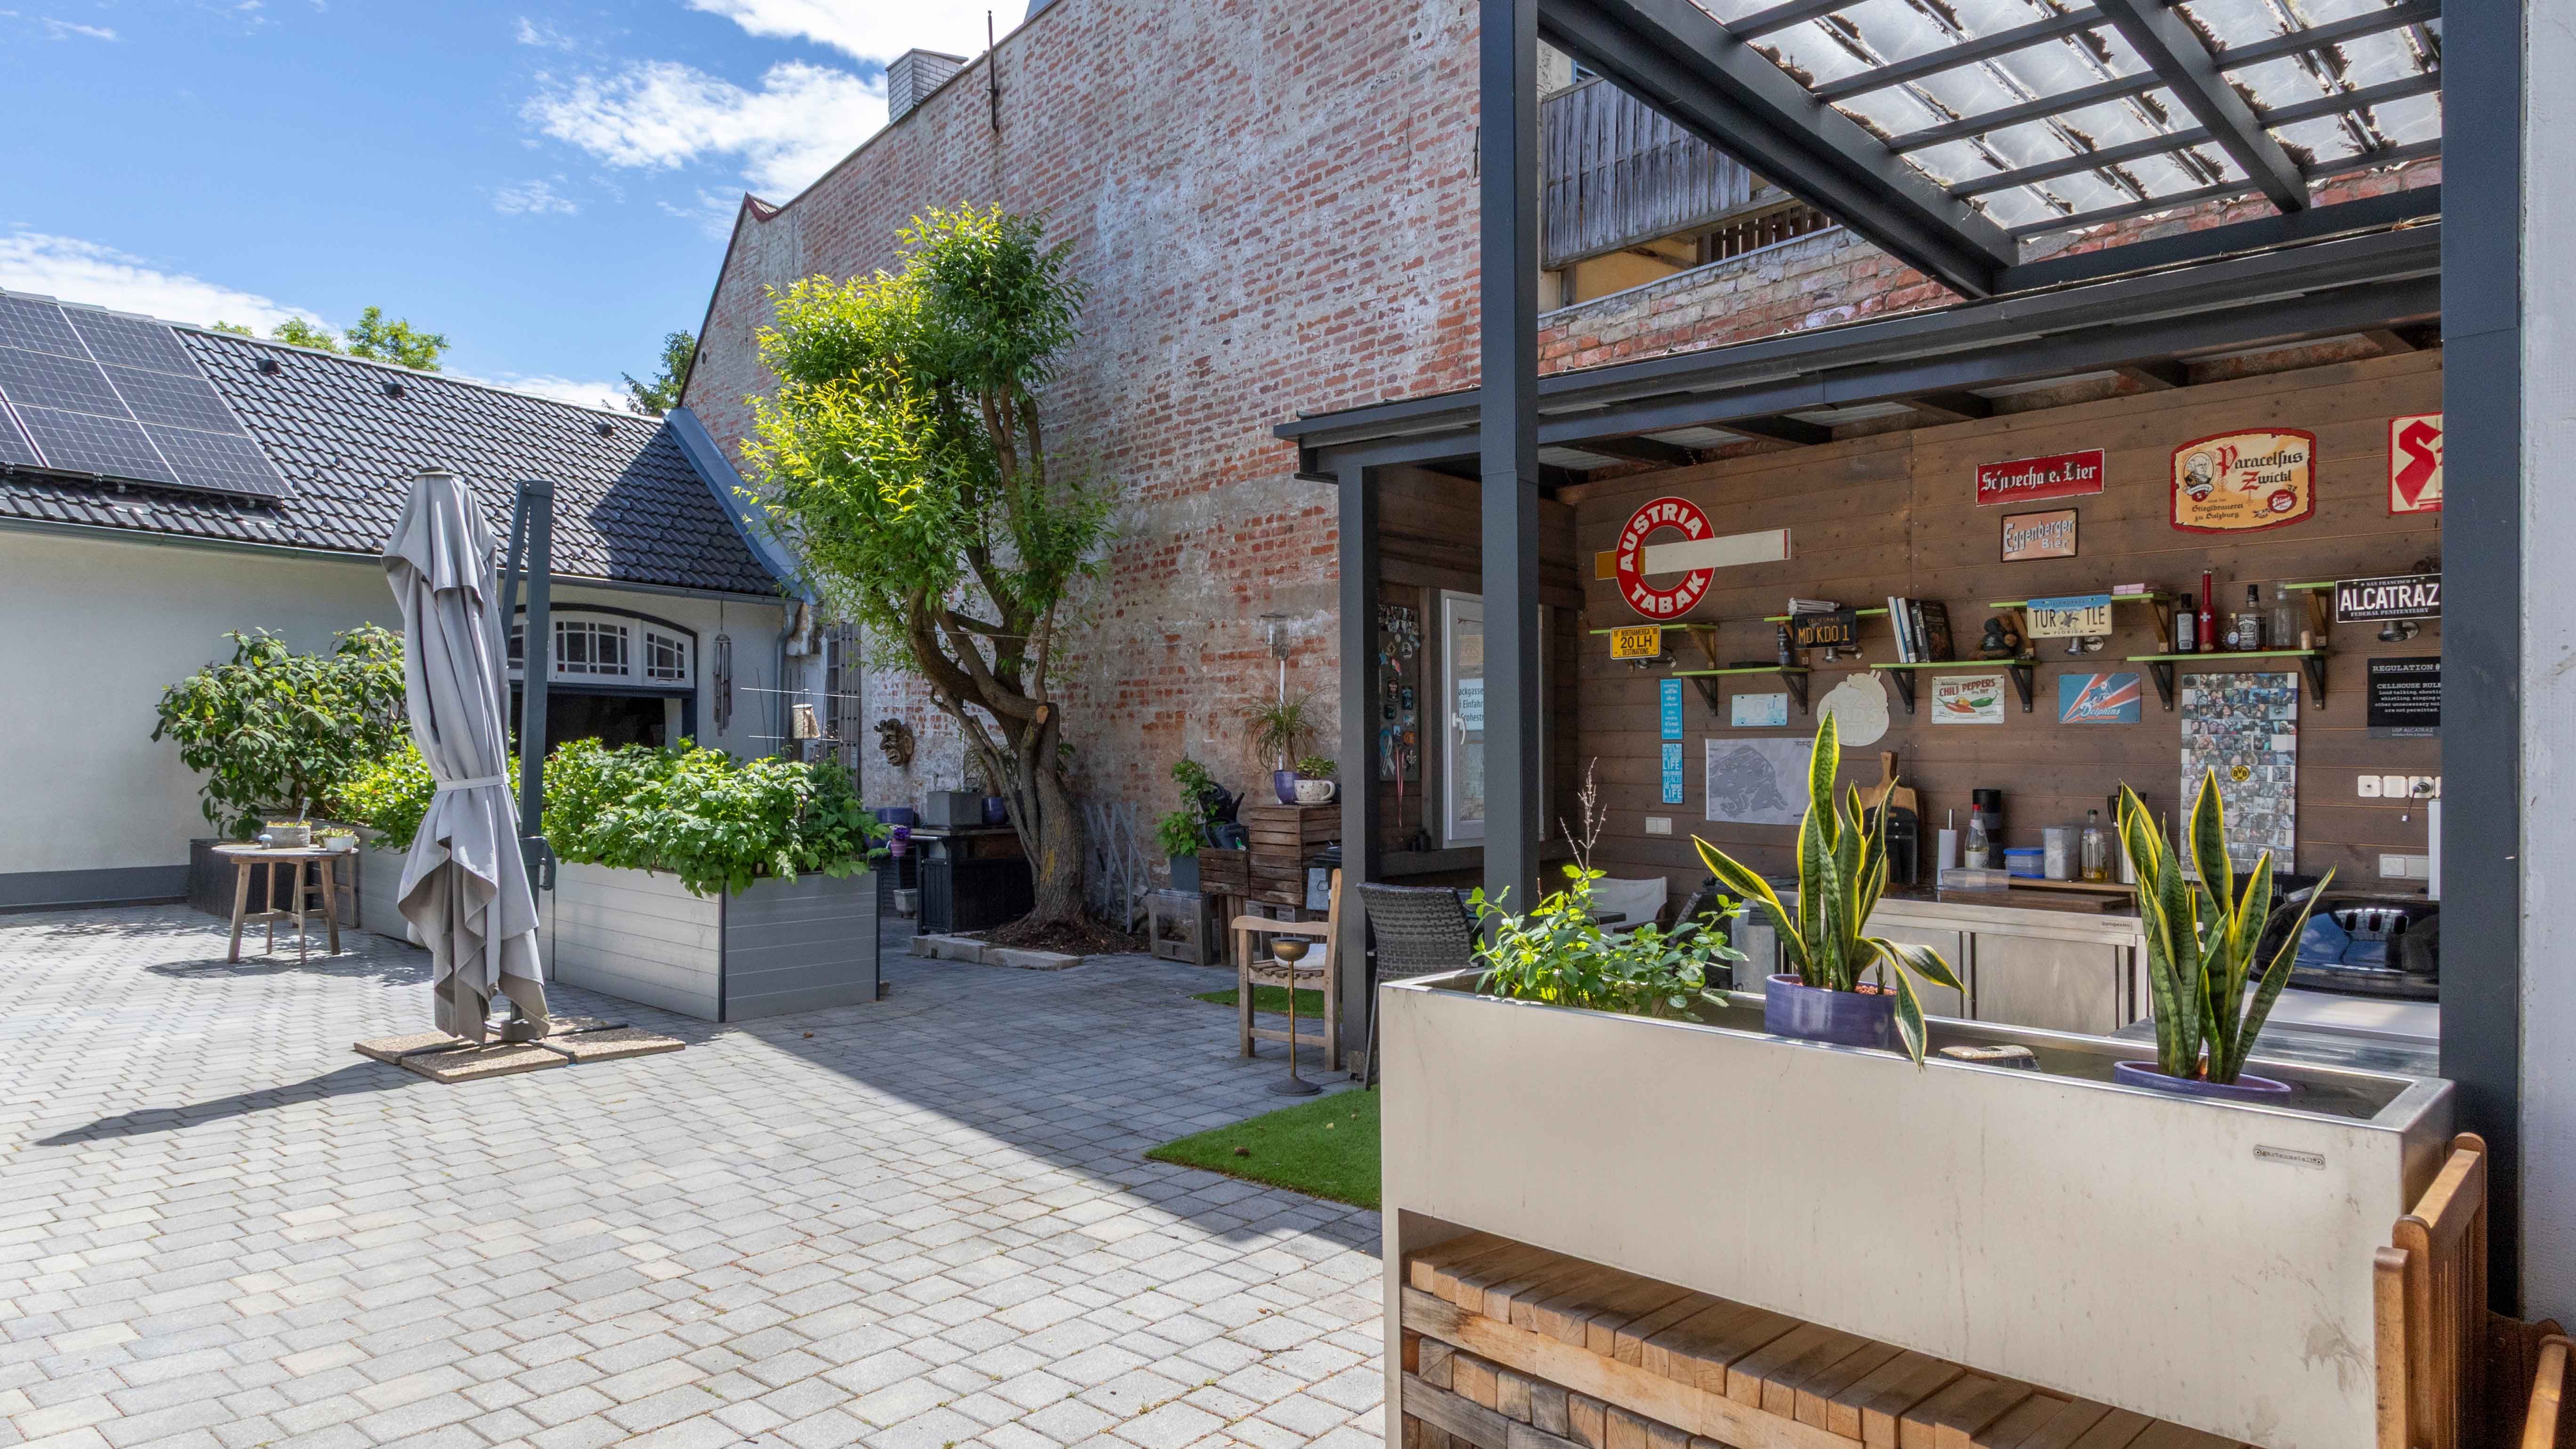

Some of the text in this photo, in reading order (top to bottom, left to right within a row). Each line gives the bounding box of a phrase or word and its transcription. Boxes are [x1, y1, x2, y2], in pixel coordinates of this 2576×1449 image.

[2239, 469, 2292, 492] Zwickl
[2206, 512, 2239, 521] Salzburg
[1620, 503, 1702, 572] AUSTRIA
[2004, 520, 2074, 553] Eggenberger
[2041, 538, 2069, 550] Bier
[1631, 571, 1706, 613] TABAK
[2340, 583, 2440, 612] ALCATRAZ
[2033, 606, 2105, 628] TUR TLE
[2380, 607, 2429, 615] PENITENTIARY
[1798, 627, 1813, 644] MD
[1843, 625, 1850, 641] 1
[1620, 635, 1651, 649] 20 LH
[1458, 687, 1484, 697] ackgasse
[1940, 686, 1959, 696] CHILI
[1962, 678, 1996, 692] PEPPERS
[1463, 700, 1484, 708] Einfahr
[2080, 701, 2120, 716] Dolphins
[1663, 760, 1680, 770] LIFE
[2233, 767, 2247, 777] BVB
[1664, 789, 1682, 798] LIFE
